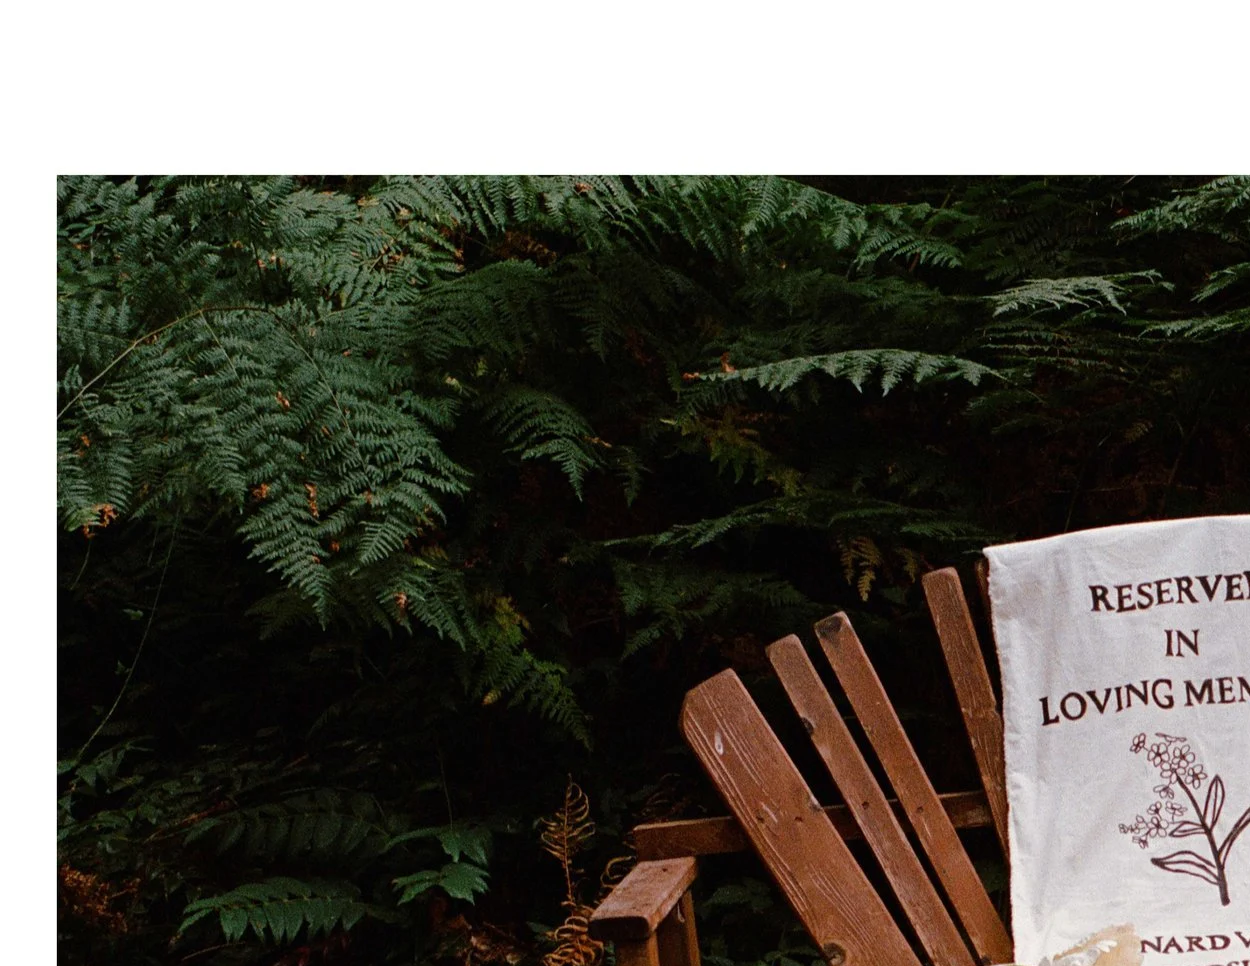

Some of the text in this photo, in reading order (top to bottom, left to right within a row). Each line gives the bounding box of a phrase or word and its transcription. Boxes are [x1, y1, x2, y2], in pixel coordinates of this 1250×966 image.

[1163, 628, 1200, 658] IN
[1039, 677, 1175, 726] LOVING
[1140, 934, 1231, 954] NARD
